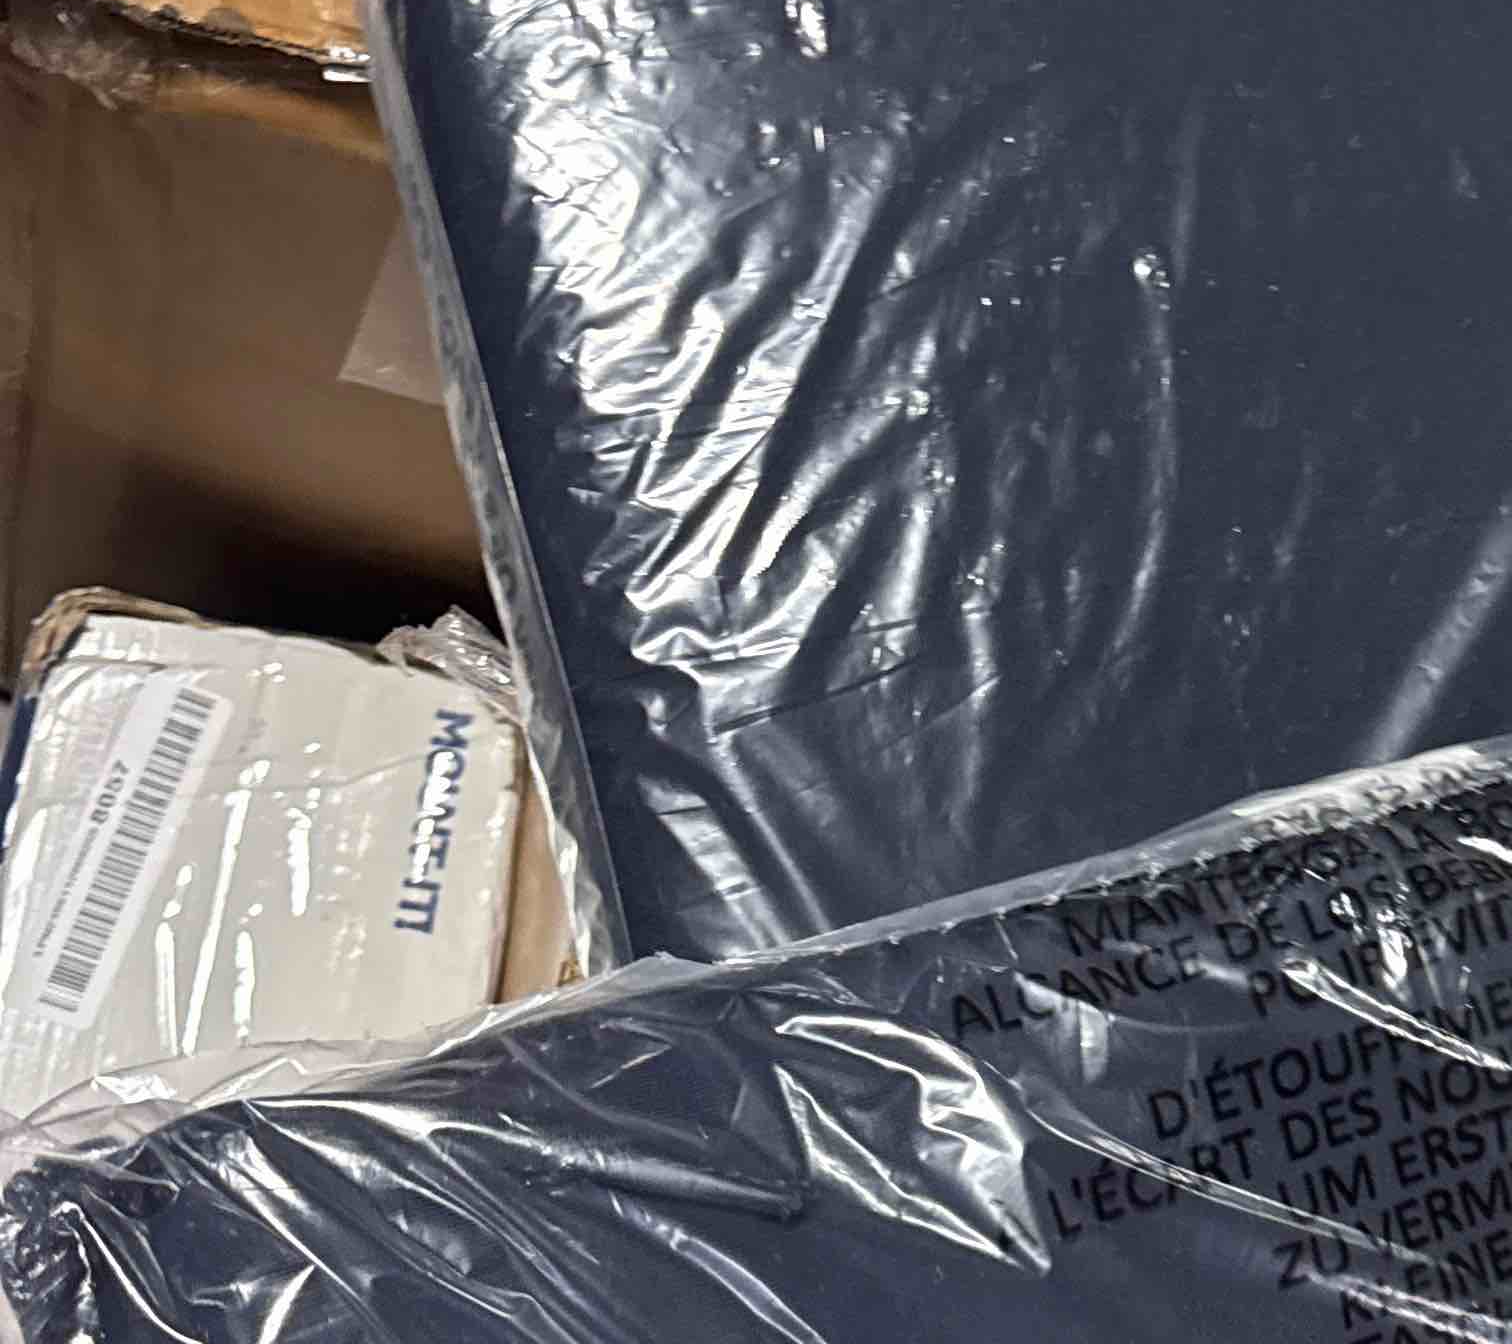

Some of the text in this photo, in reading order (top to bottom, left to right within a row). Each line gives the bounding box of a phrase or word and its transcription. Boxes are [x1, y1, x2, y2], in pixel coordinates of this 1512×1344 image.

[93, 757, 131, 827] 8057
[392, 709, 476, 934] MOT-IT!
[1215, 903, 1292, 961] DE
[1304, 877, 1400, 945] LOS
[1279, 1089, 1384, 1160] DES
[1279, 1158, 1378, 1220] UM
[1272, 1237, 1350, 1291] ZU
